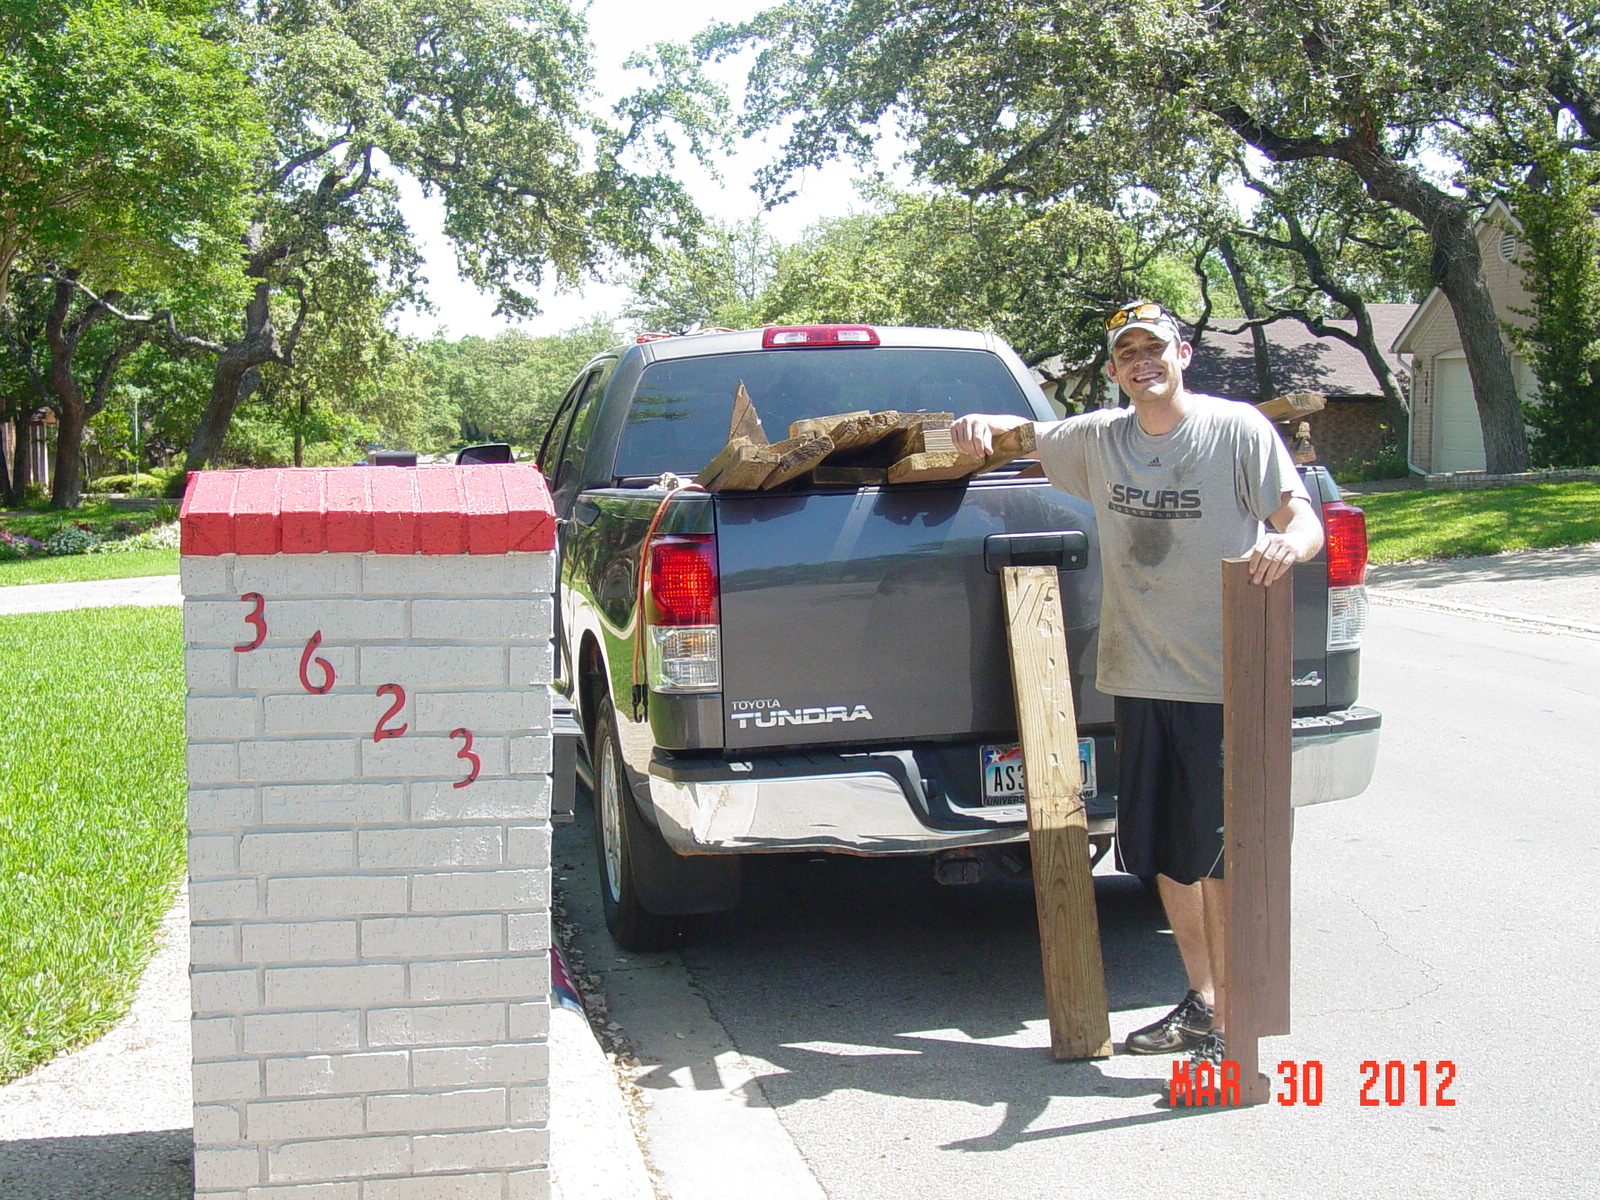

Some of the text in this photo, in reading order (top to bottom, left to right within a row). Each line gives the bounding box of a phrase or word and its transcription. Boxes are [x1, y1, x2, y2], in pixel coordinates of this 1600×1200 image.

[1112, 483, 1202, 509] SPURS
[730, 704, 874, 729] TUNDRA
[731, 699, 781, 711] TOYOTA
